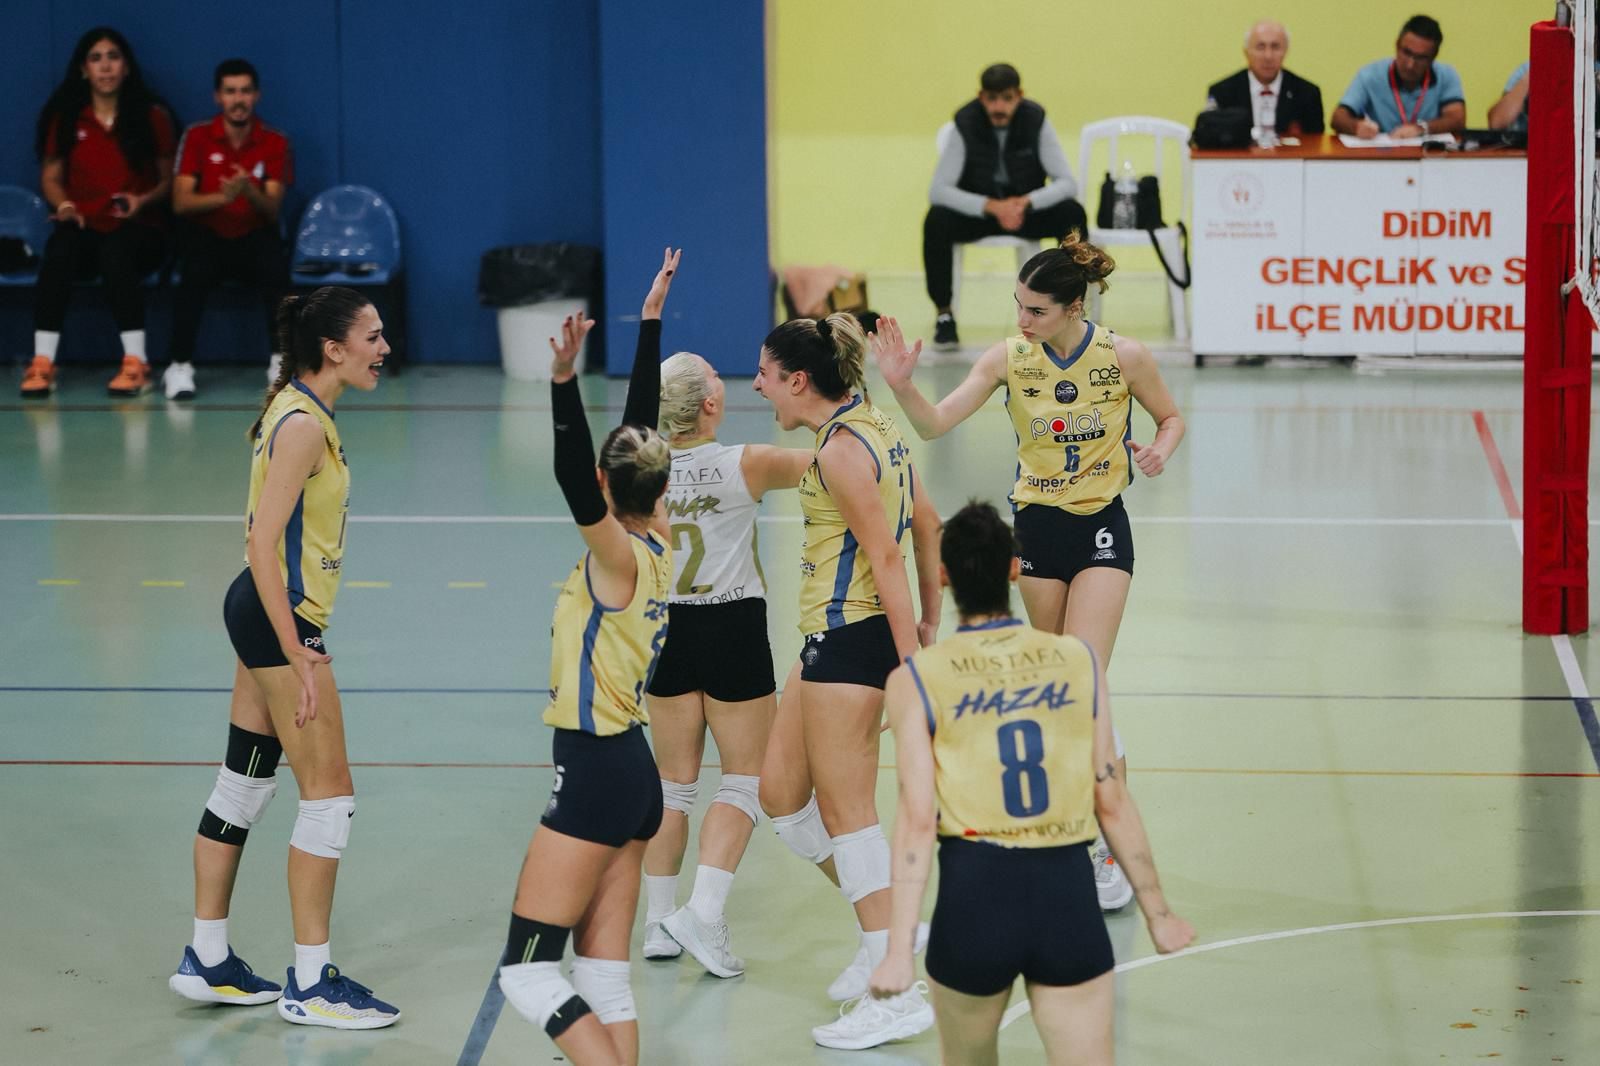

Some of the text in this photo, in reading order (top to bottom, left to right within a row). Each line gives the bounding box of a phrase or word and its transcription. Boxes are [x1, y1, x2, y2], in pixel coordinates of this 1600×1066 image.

[1448, 265, 1492, 285] ve
[1353, 297, 1526, 332] MÜDÜRL
[1031, 408, 1107, 440] polat
[1059, 431, 1101, 442] GROUP
[1095, 527, 1114, 549] 6
[670, 522, 713, 595] 2
[951, 648, 1066, 673] MUSTAFA
[954, 681, 1076, 719] HAZAL
[997, 719, 1049, 819] 8
